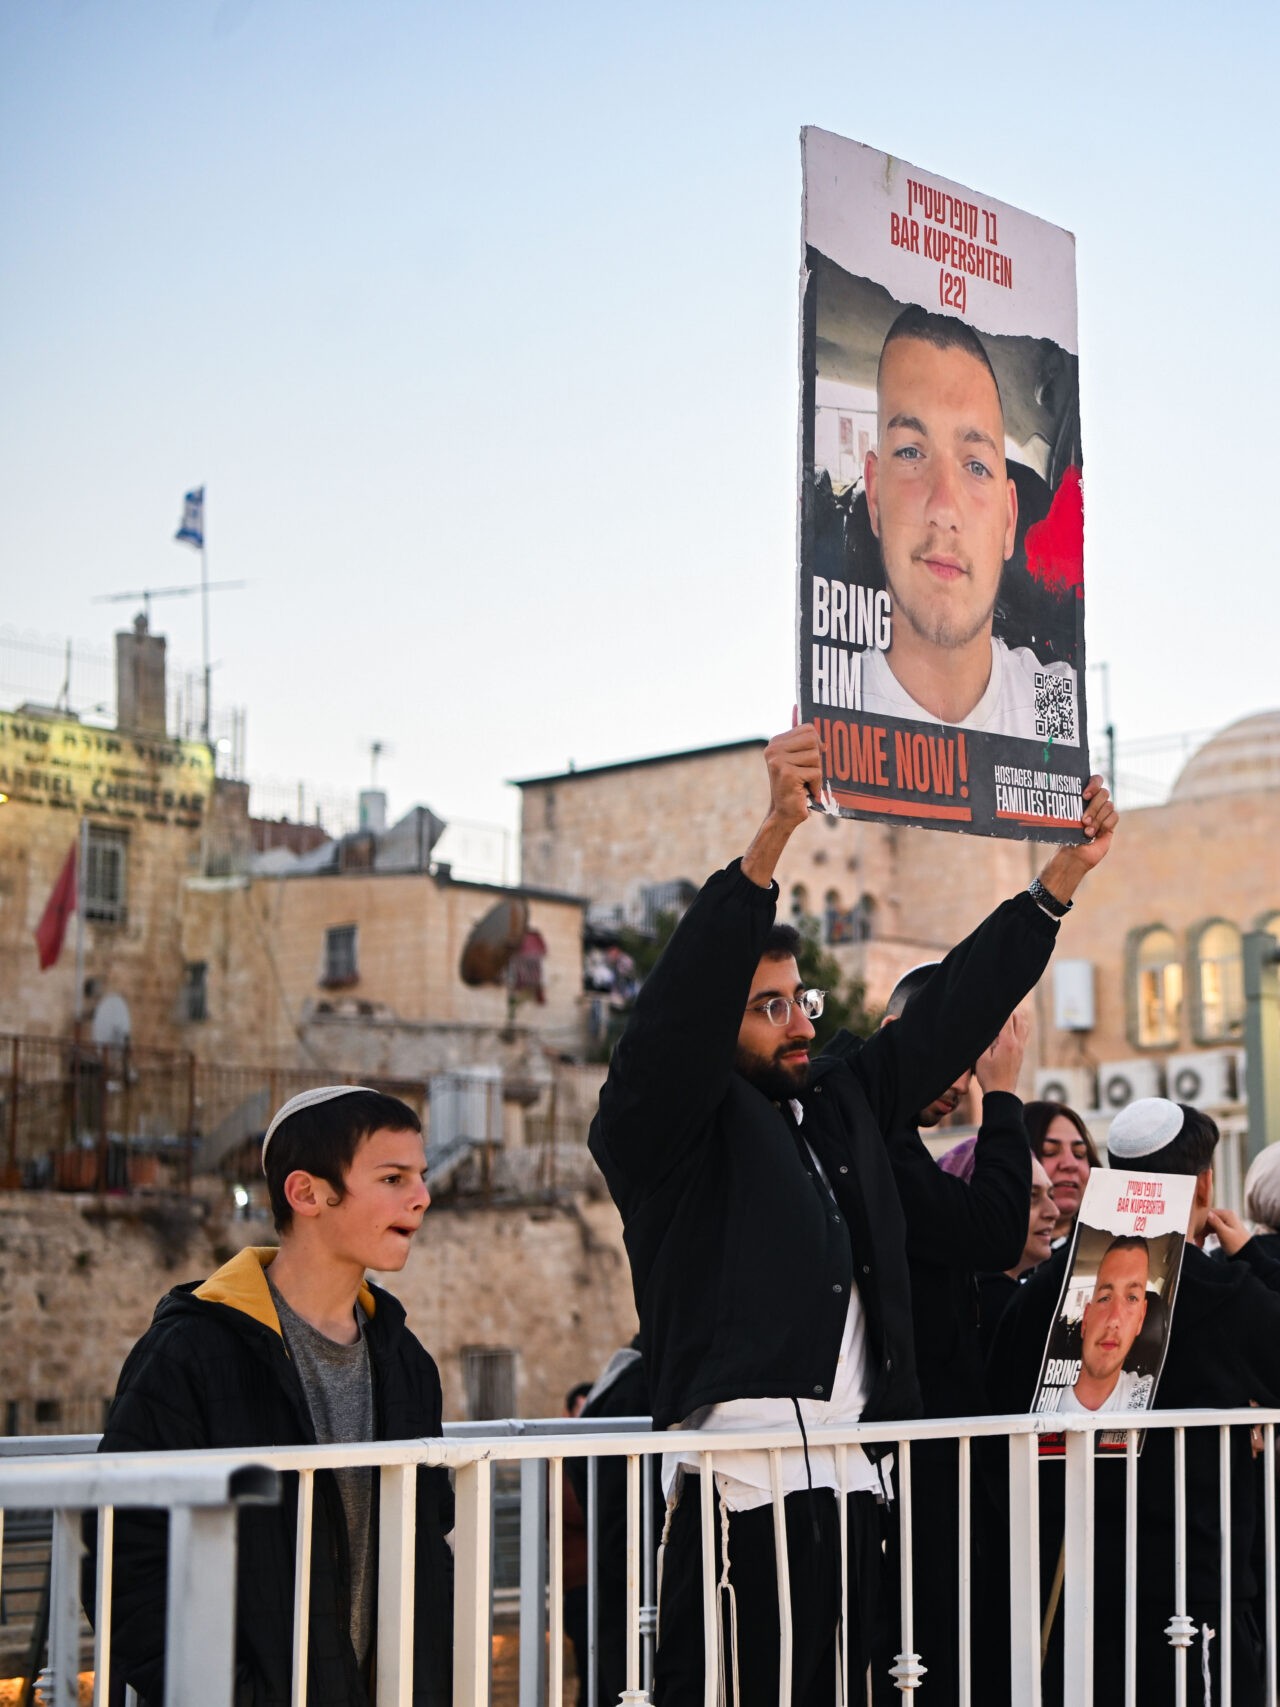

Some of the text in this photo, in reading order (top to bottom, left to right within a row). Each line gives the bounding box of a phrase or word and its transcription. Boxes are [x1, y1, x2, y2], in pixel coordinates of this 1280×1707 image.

[906, 178, 998, 246] בר קופרשטיין
[890, 211, 1013, 290] BAR KUPERSHTEIN
[939, 267, 967, 315] (22)
[812, 575, 891, 650] BRING
[811, 643, 862, 711] HIM
[813, 716, 970, 799] HOME NOW!
[994, 764, 1082, 795] HOSTAGES AND MISSING
[995, 784, 1083, 822] FAMILIES FORUM
[1117, 1197, 1129, 1213] BAR
[1133, 1216, 1147, 1232] (22)
[1043, 1358, 1083, 1386] BRING
[1036, 1387, 1063, 1413] HIM
